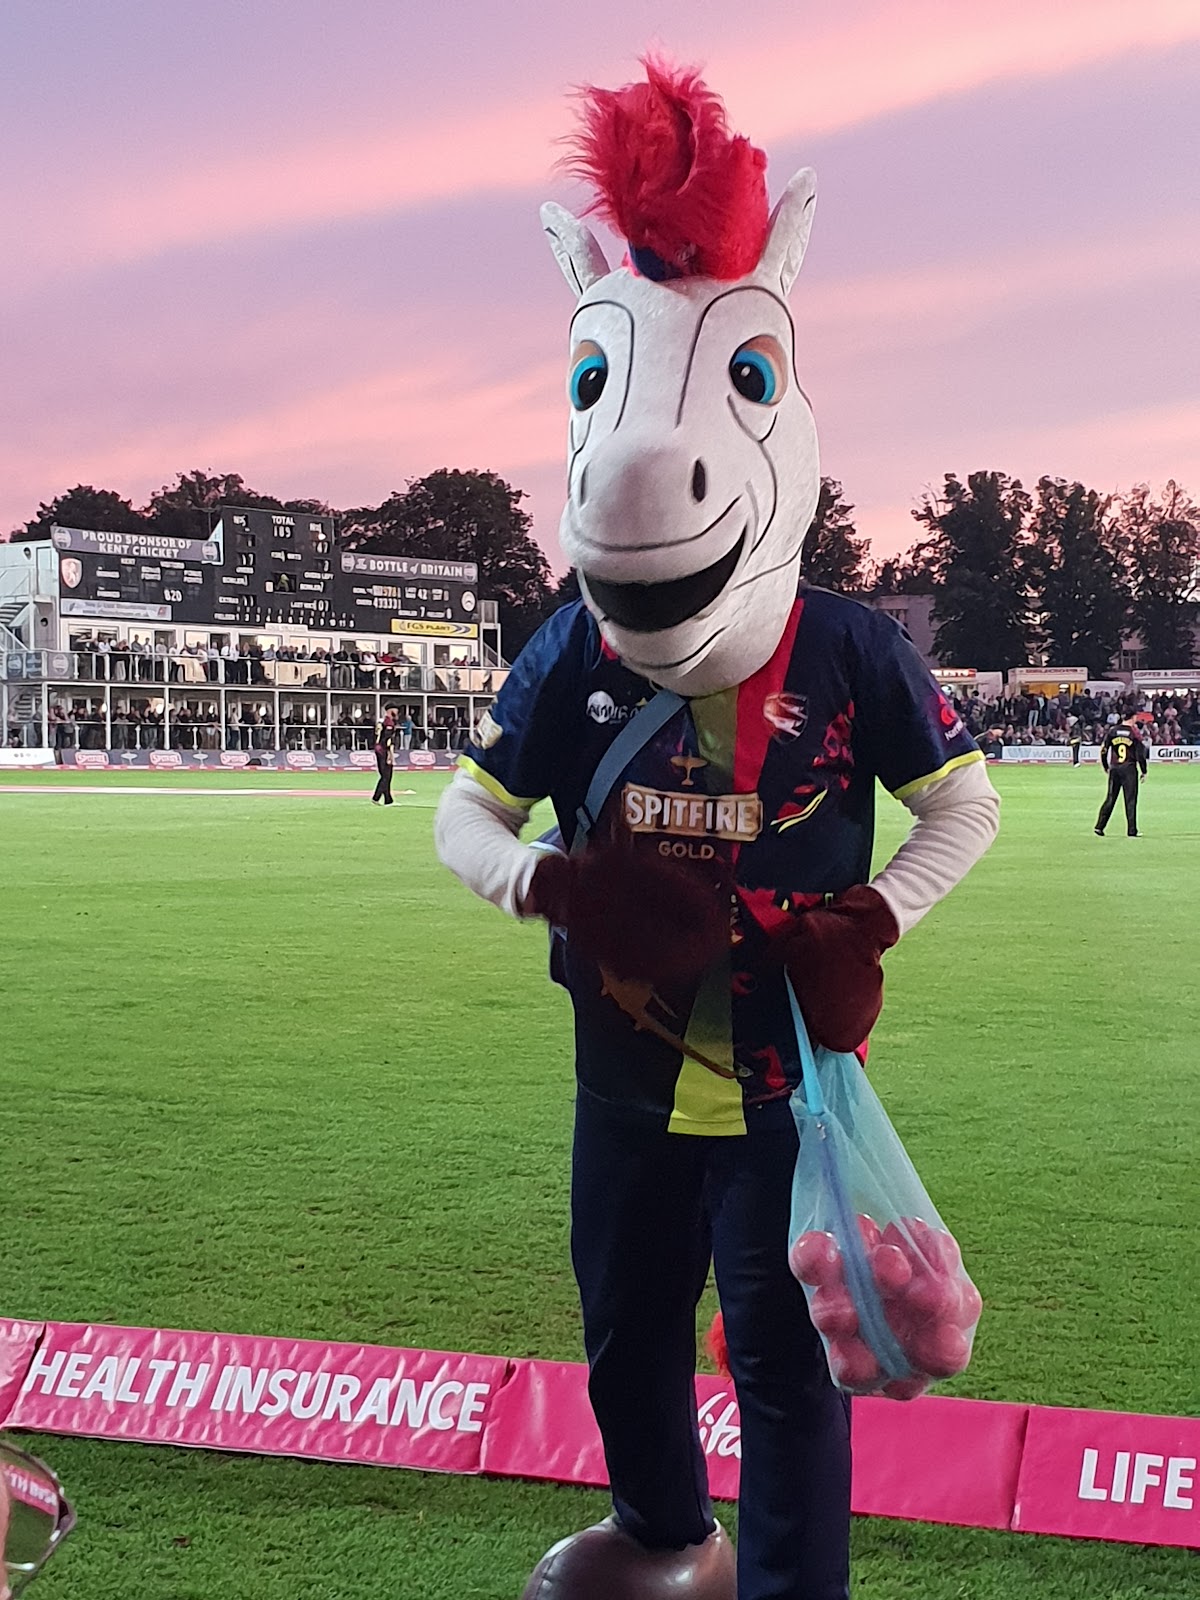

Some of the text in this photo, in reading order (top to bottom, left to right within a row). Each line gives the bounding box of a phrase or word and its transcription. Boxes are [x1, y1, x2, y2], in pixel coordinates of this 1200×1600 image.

[271, 515, 295, 526] TOTAL
[82, 530, 122, 544] PROUD
[125, 534, 176, 548] SPONSOR
[178, 540, 192, 550] OF
[99, 543, 179, 558] KENT CRICKET
[369, 559, 408, 572] BOTTLE
[420, 563, 463, 577] BRITAIN
[1117, 744, 1127, 763] 9
[1157, 748, 1199, 759] Girlings
[625, 790, 753, 833] SPITFIRE
[658, 840, 715, 860] GOLD
[22, 1348, 490, 1432] HEALTH INSURANCE
[1078, 1448, 1197, 1510] LIFE
